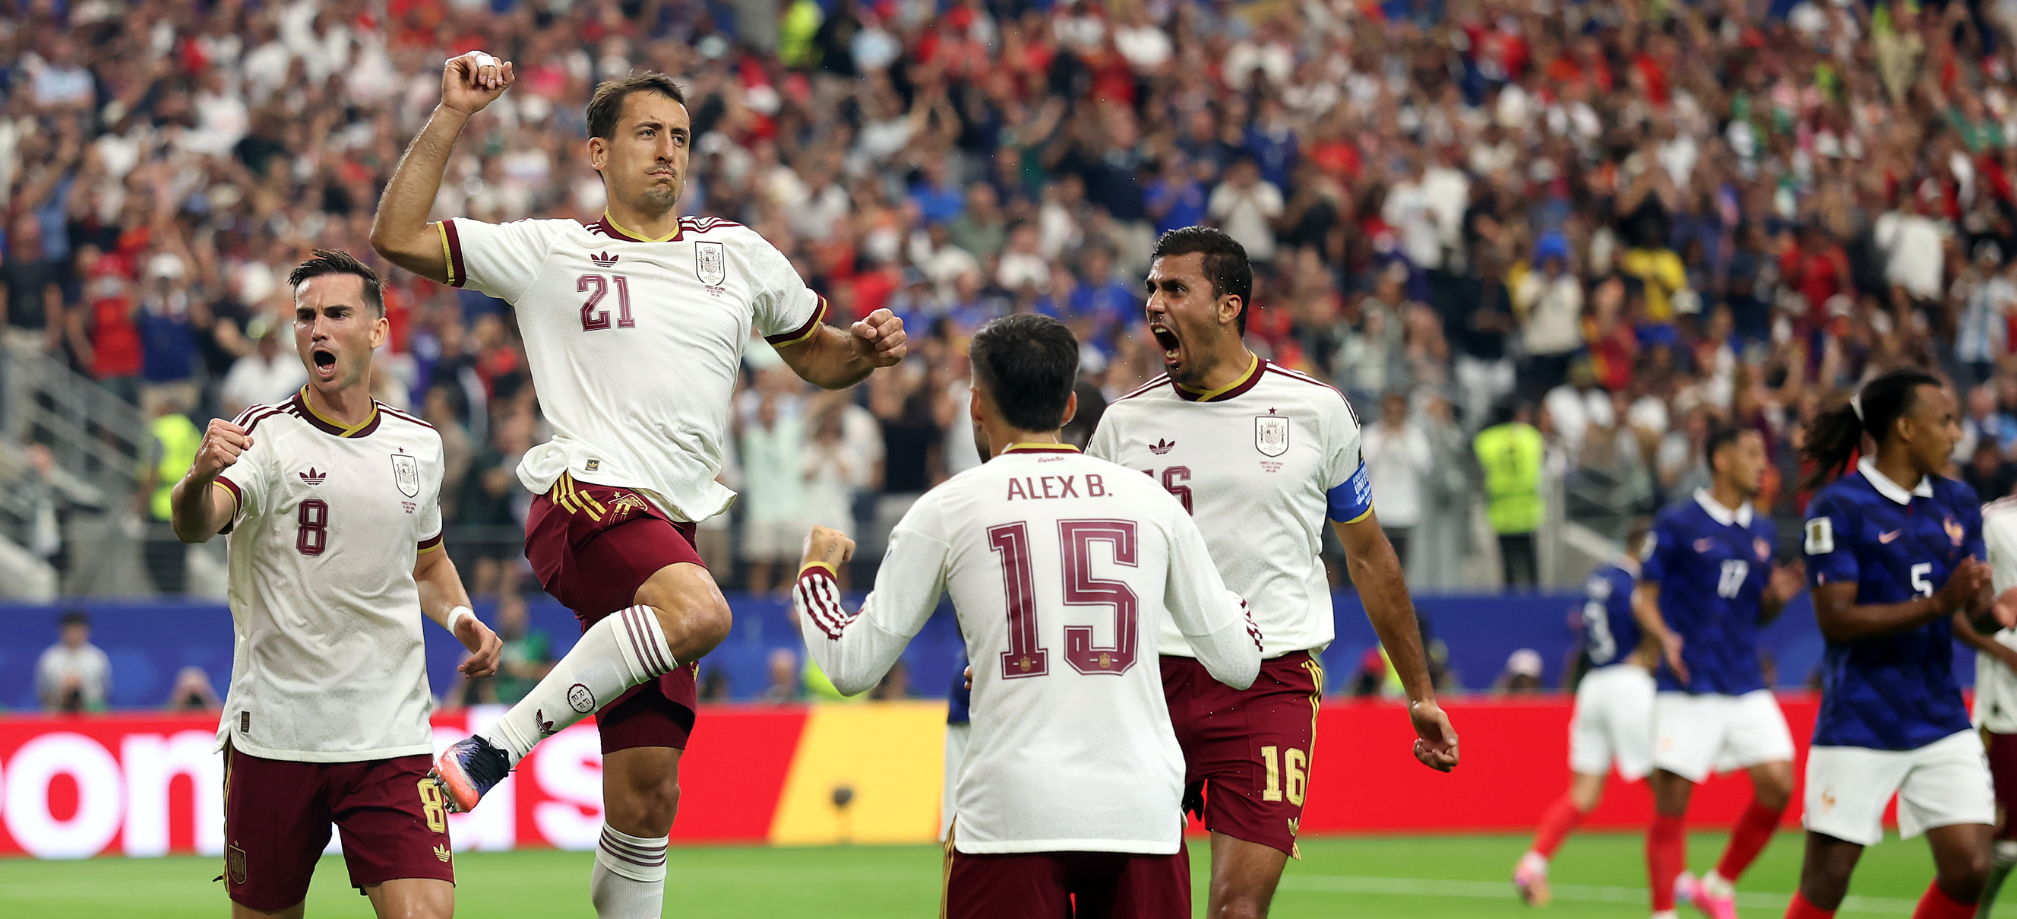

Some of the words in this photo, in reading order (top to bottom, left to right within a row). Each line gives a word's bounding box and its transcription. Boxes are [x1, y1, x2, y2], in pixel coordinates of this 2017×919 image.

[576, 273, 636, 332] 21
[1007, 474, 1080, 501] ALEX
[1085, 473, 1113, 497] B.
[1141, 465, 1194, 517] 6
[296, 498, 329, 556] 8
[986, 518, 1140, 680] 15
[1717, 559, 1750, 599] 17
[1910, 562, 1934, 601] 5
[1261, 746, 1307, 807] 16
[417, 778, 446, 833] 8
